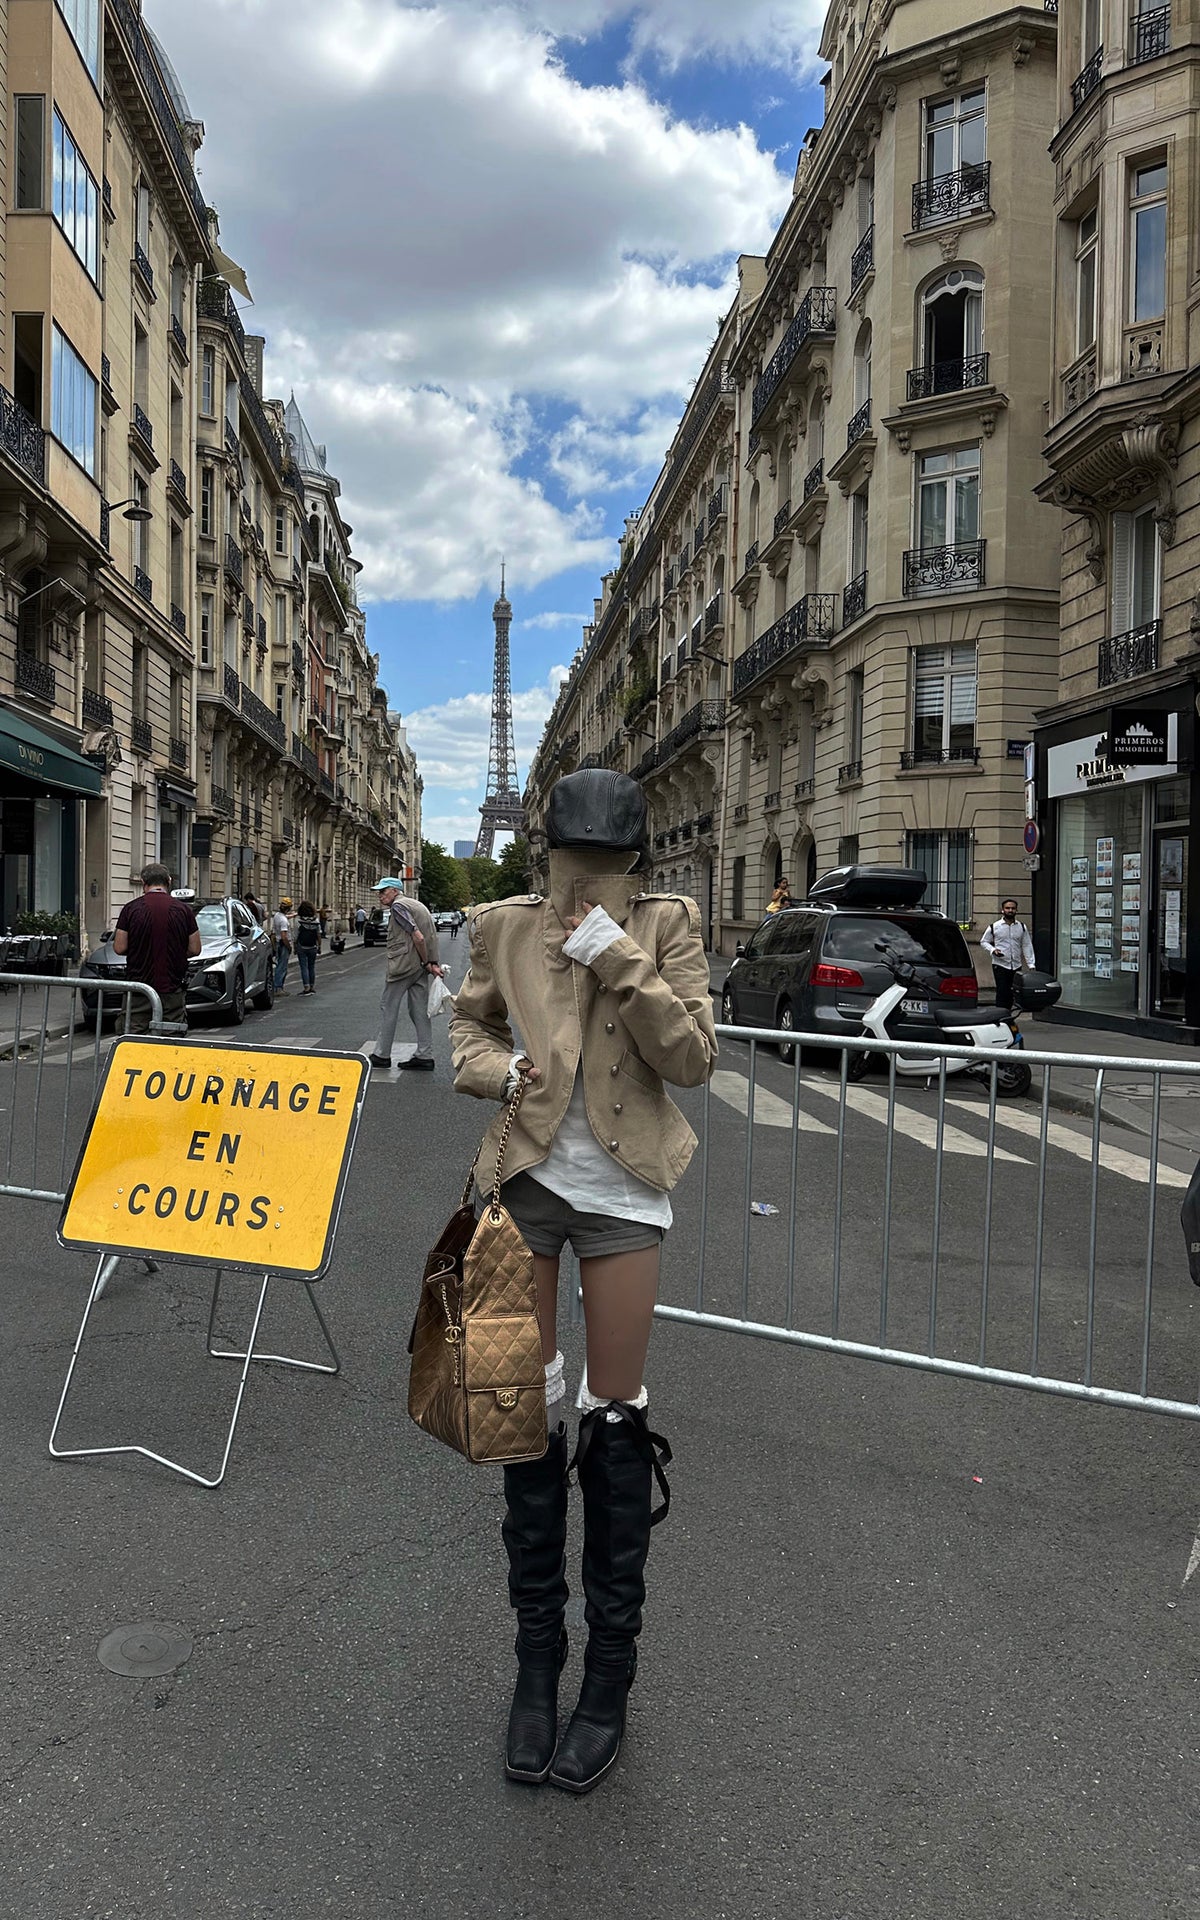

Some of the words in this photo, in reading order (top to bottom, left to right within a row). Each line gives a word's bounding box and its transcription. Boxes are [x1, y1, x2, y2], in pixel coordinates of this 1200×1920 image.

[1114, 737, 1165, 745] PRIMEROS
[1076, 758, 1137, 779] PRIM
[124, 1069, 341, 1115] TOURNAGE
[186, 1130, 241, 1164] EN
[127, 1183, 271, 1230] COURS
